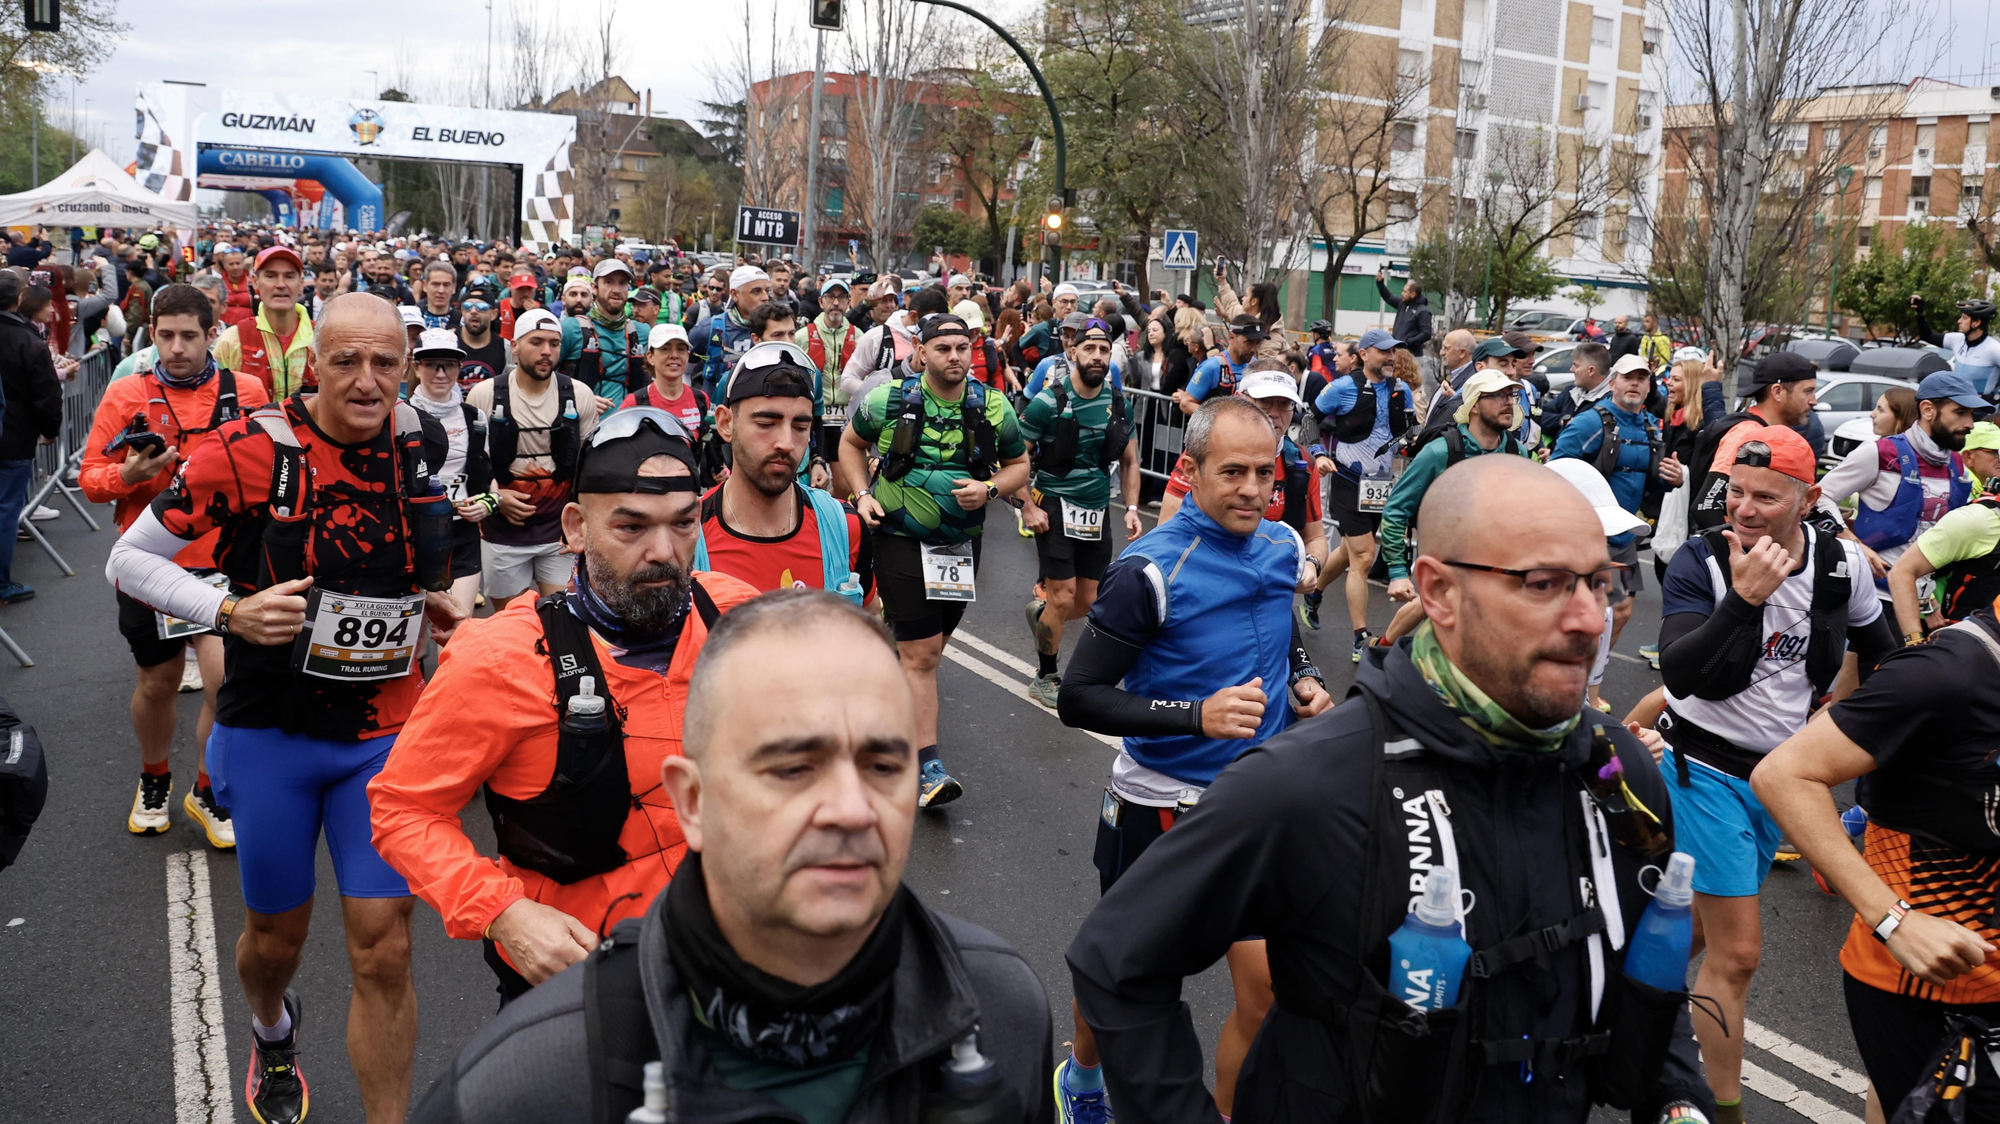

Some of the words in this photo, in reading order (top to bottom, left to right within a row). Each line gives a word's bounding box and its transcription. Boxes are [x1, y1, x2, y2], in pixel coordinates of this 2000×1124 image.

[221, 112, 316, 133] GUZMÁN
[411, 126, 434, 141] EL
[438, 128, 505, 146] BUENO
[218, 151, 306, 169] CABELLO
[758, 210, 783, 221] ACCESO
[754, 220, 785, 238] MTB
[826, 405, 846, 416] 871
[277, 454, 289, 498] AONIJIE
[1366, 488, 1390, 500] 934
[1069, 510, 1098, 525] 110
[937, 565, 960, 583] 78
[375, 603, 403, 611] GUZMÁN
[334, 617, 410, 648] 894
[340, 665, 362, 673] TRAIL
[362, 664, 388, 673] RUNING
[1149, 699, 1192, 711] ELTIN
[1433, 979, 1447, 1009] LIMITS
